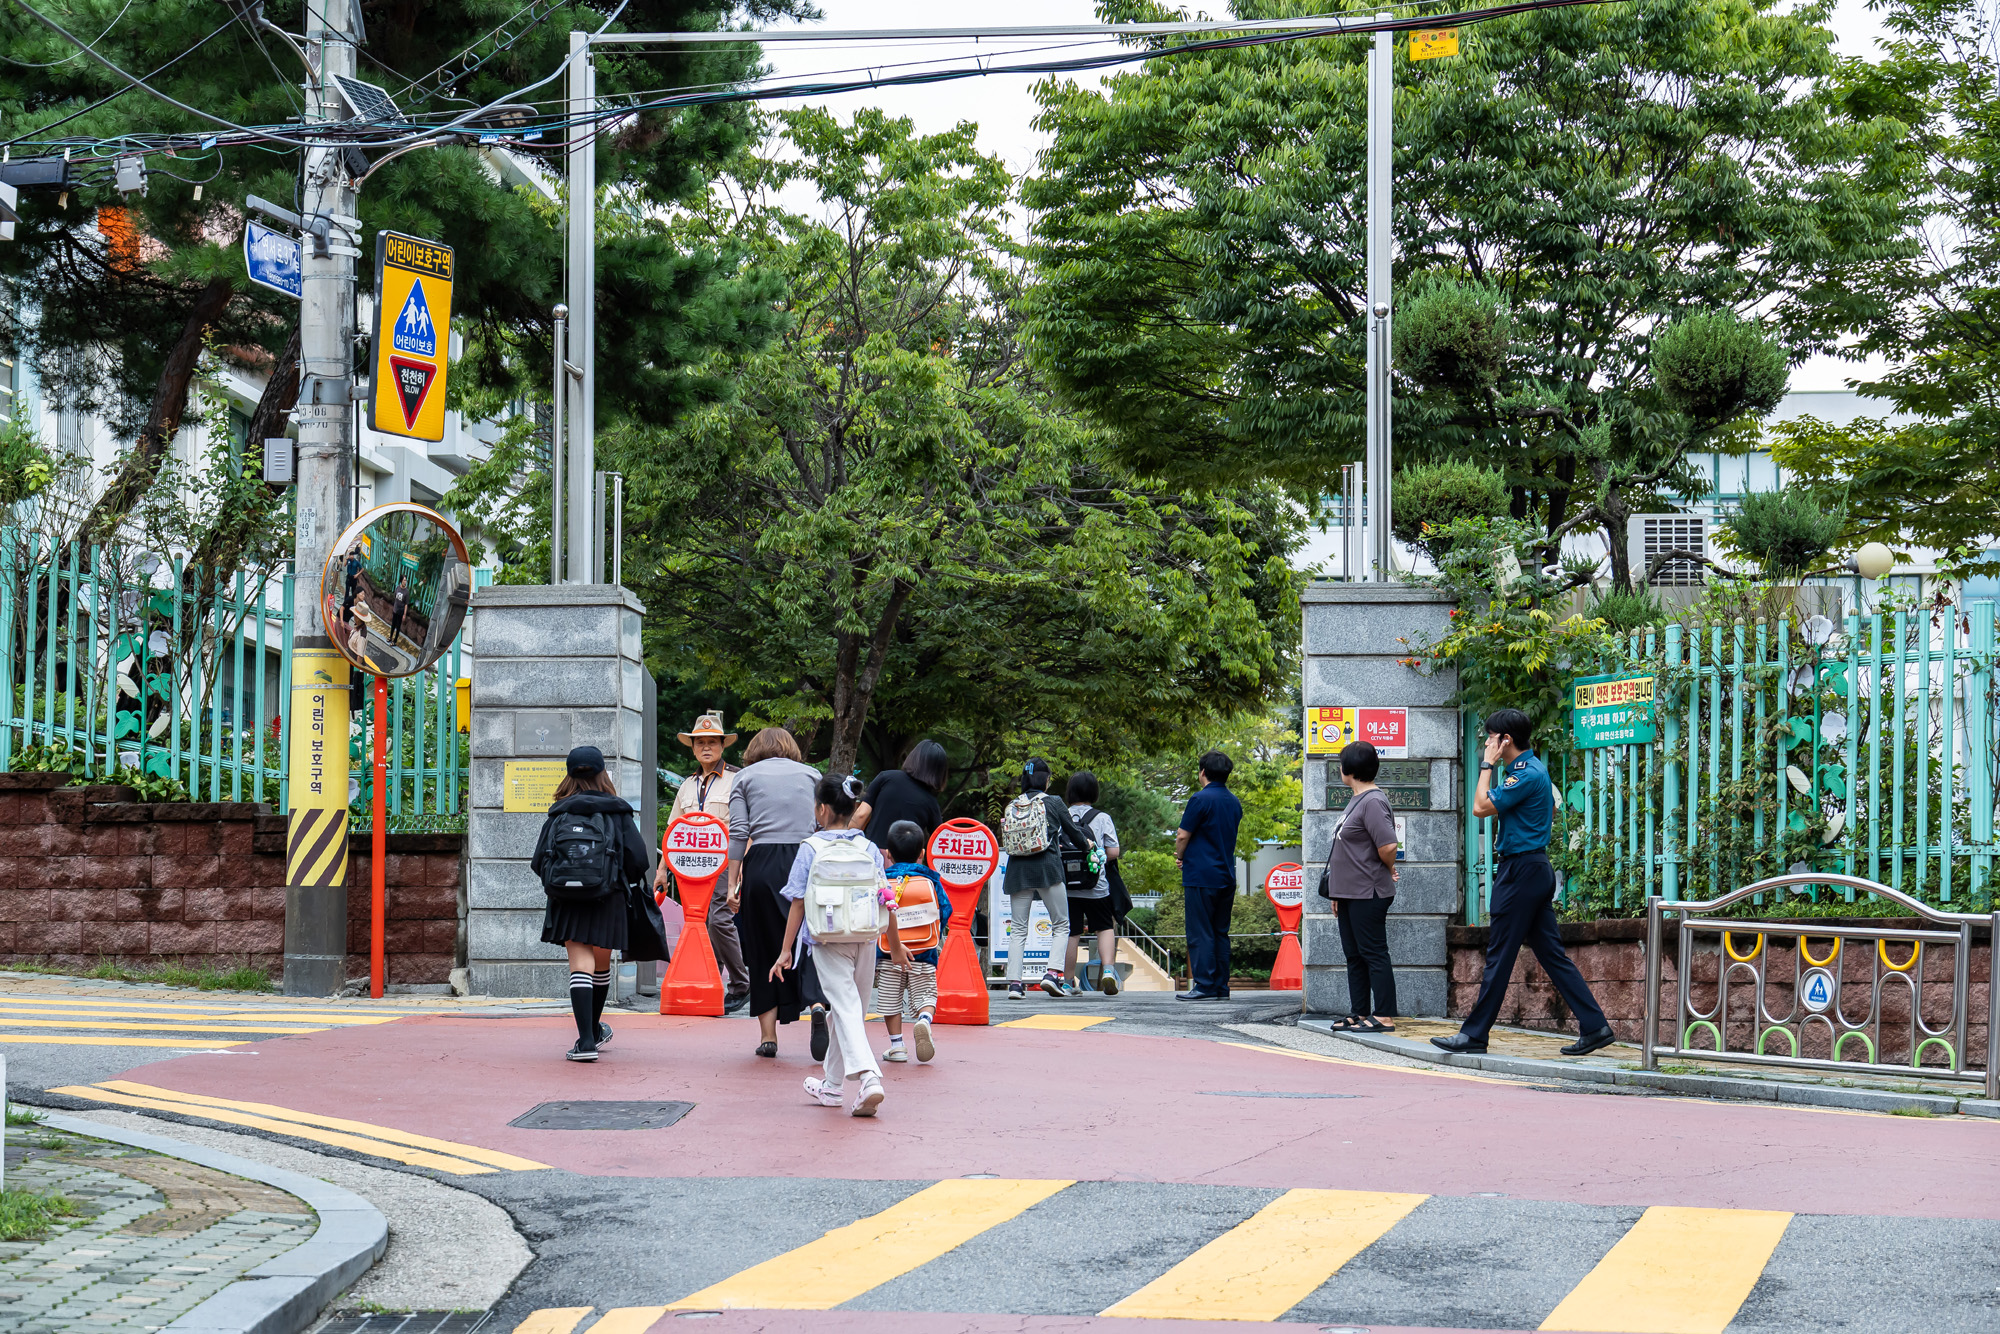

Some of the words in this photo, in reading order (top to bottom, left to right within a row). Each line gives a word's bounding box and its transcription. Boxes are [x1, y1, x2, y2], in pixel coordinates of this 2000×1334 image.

[388, 238, 450, 277] 어린이보호구역
[396, 334, 433, 354] 어린이보호
[401, 368, 425, 387] 천천히
[404, 384, 420, 395] SLOW
[1576, 686, 1595, 706] 어린이
[1596, 684, 1609, 704] 안전
[312, 694, 325, 736] 어린이
[1612, 711, 1626, 724] 하지
[1366, 721, 1399, 735] 에스원
[1594, 728, 1635, 741] 서울연신초등학교
[310, 739, 324, 795] 보호구역
[1331, 766, 1428, 780] 서초등학교
[673, 831, 722, 849] 주차금지
[937, 837, 987, 856] 주차금지
[675, 855, 719, 868] 서울연신초등학교
[939, 862, 984, 876] 서울연신초등학교
